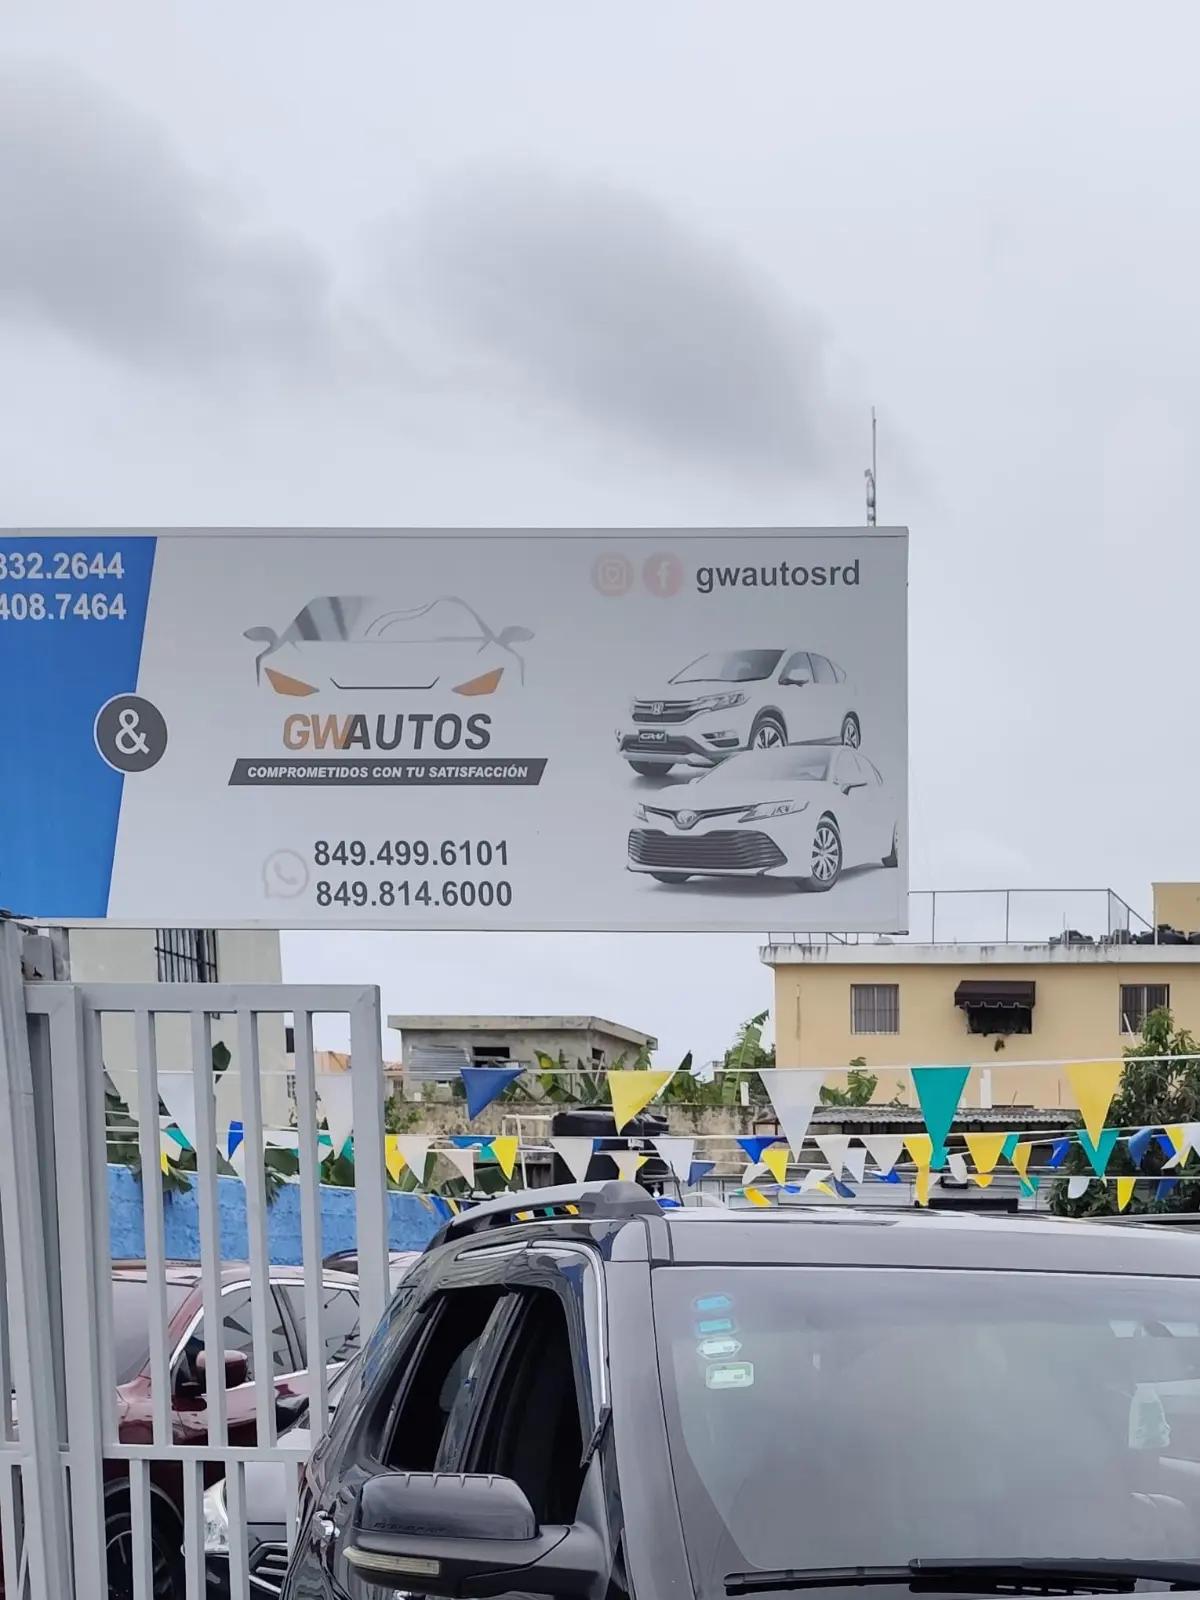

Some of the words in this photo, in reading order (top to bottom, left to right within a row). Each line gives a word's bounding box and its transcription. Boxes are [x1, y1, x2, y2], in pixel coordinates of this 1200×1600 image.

[696, 559, 860, 594] gwautosrd
[115, 708, 150, 754] &
[281, 713, 492, 750] GWAUTOS
[247, 766, 368, 778] COMPROMETIDOS
[372, 766, 402, 778] CON
[406, 766, 425, 778] TU
[428, 763, 528, 778] SATISFACCIÓN
[314, 840, 508, 866] 849.499.6101
[316, 880, 512, 907] 849.814.6000
